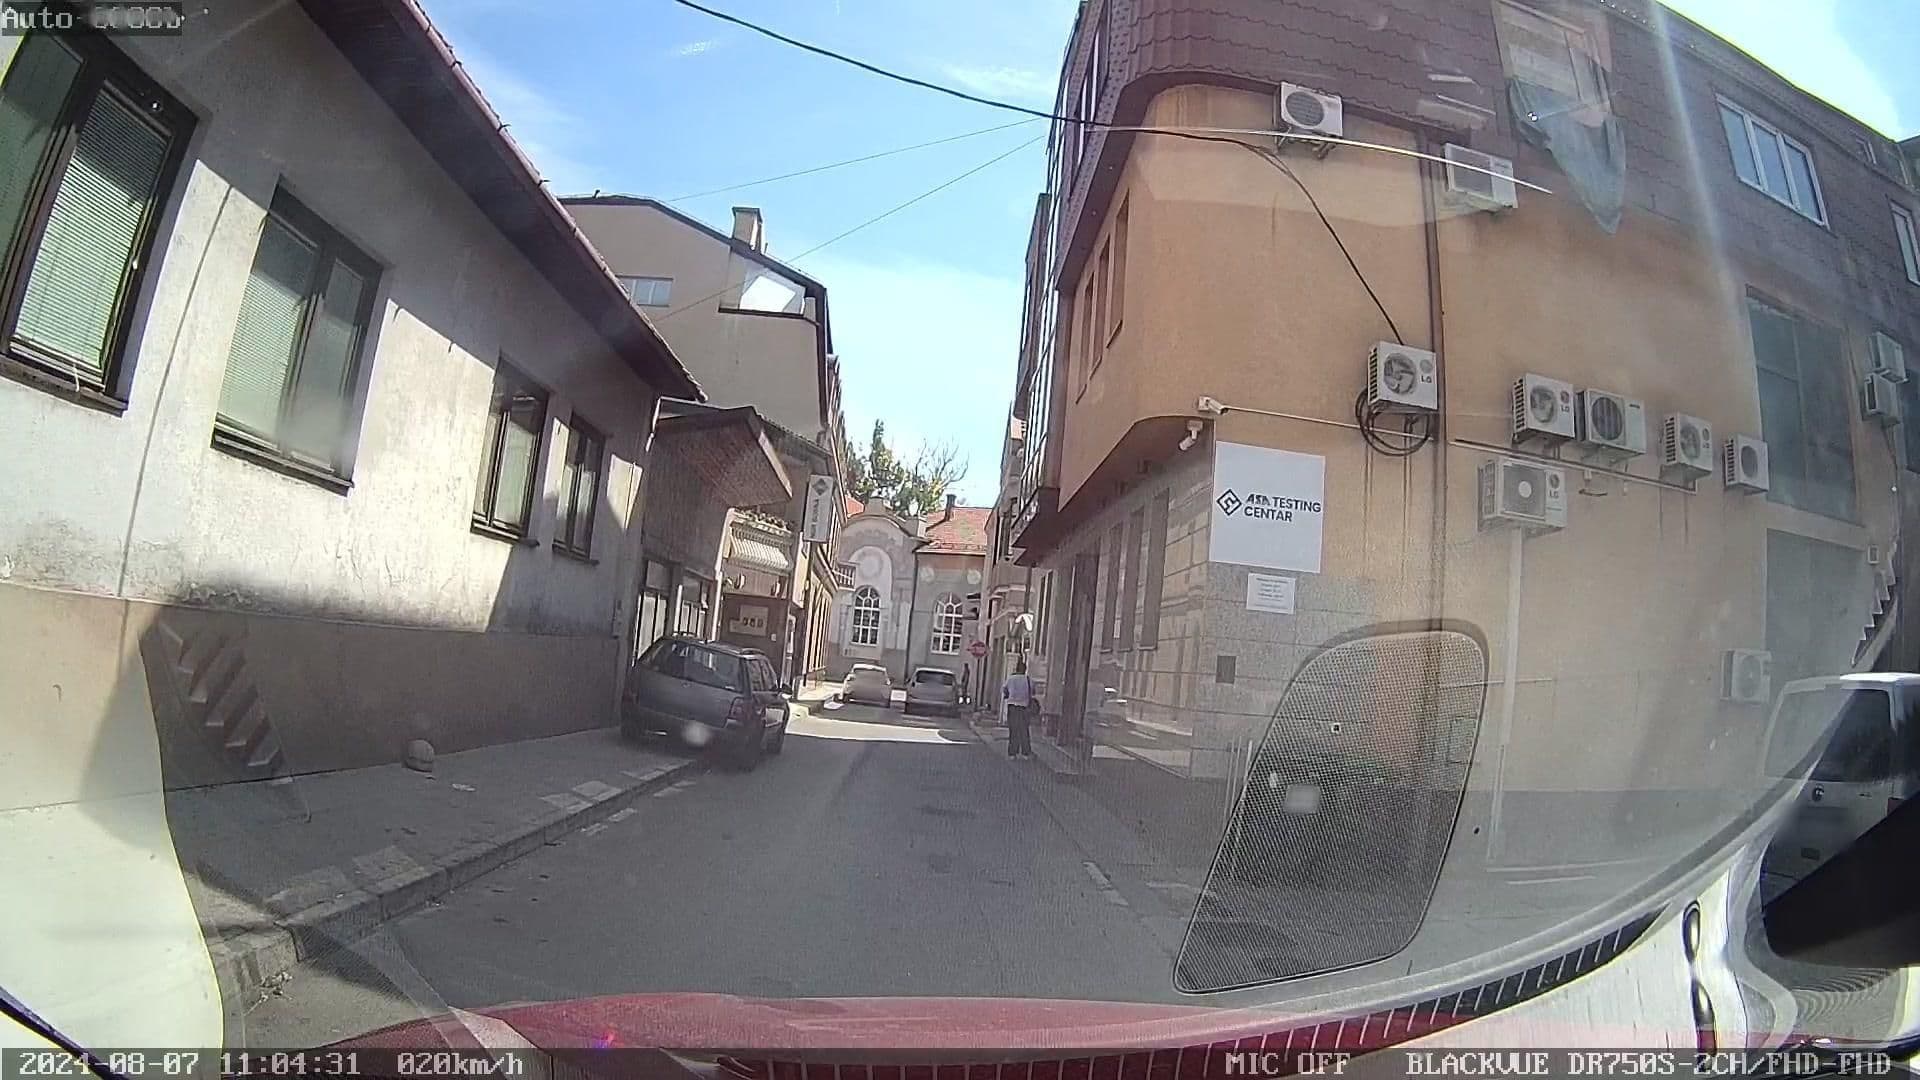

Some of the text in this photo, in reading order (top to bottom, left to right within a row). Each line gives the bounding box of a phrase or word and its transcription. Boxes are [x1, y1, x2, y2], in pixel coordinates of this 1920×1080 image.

[1421, 375, 1432, 384] LG
[1272, 496, 1322, 513] TESTING
[1244, 506, 1293, 522] CENTAR
